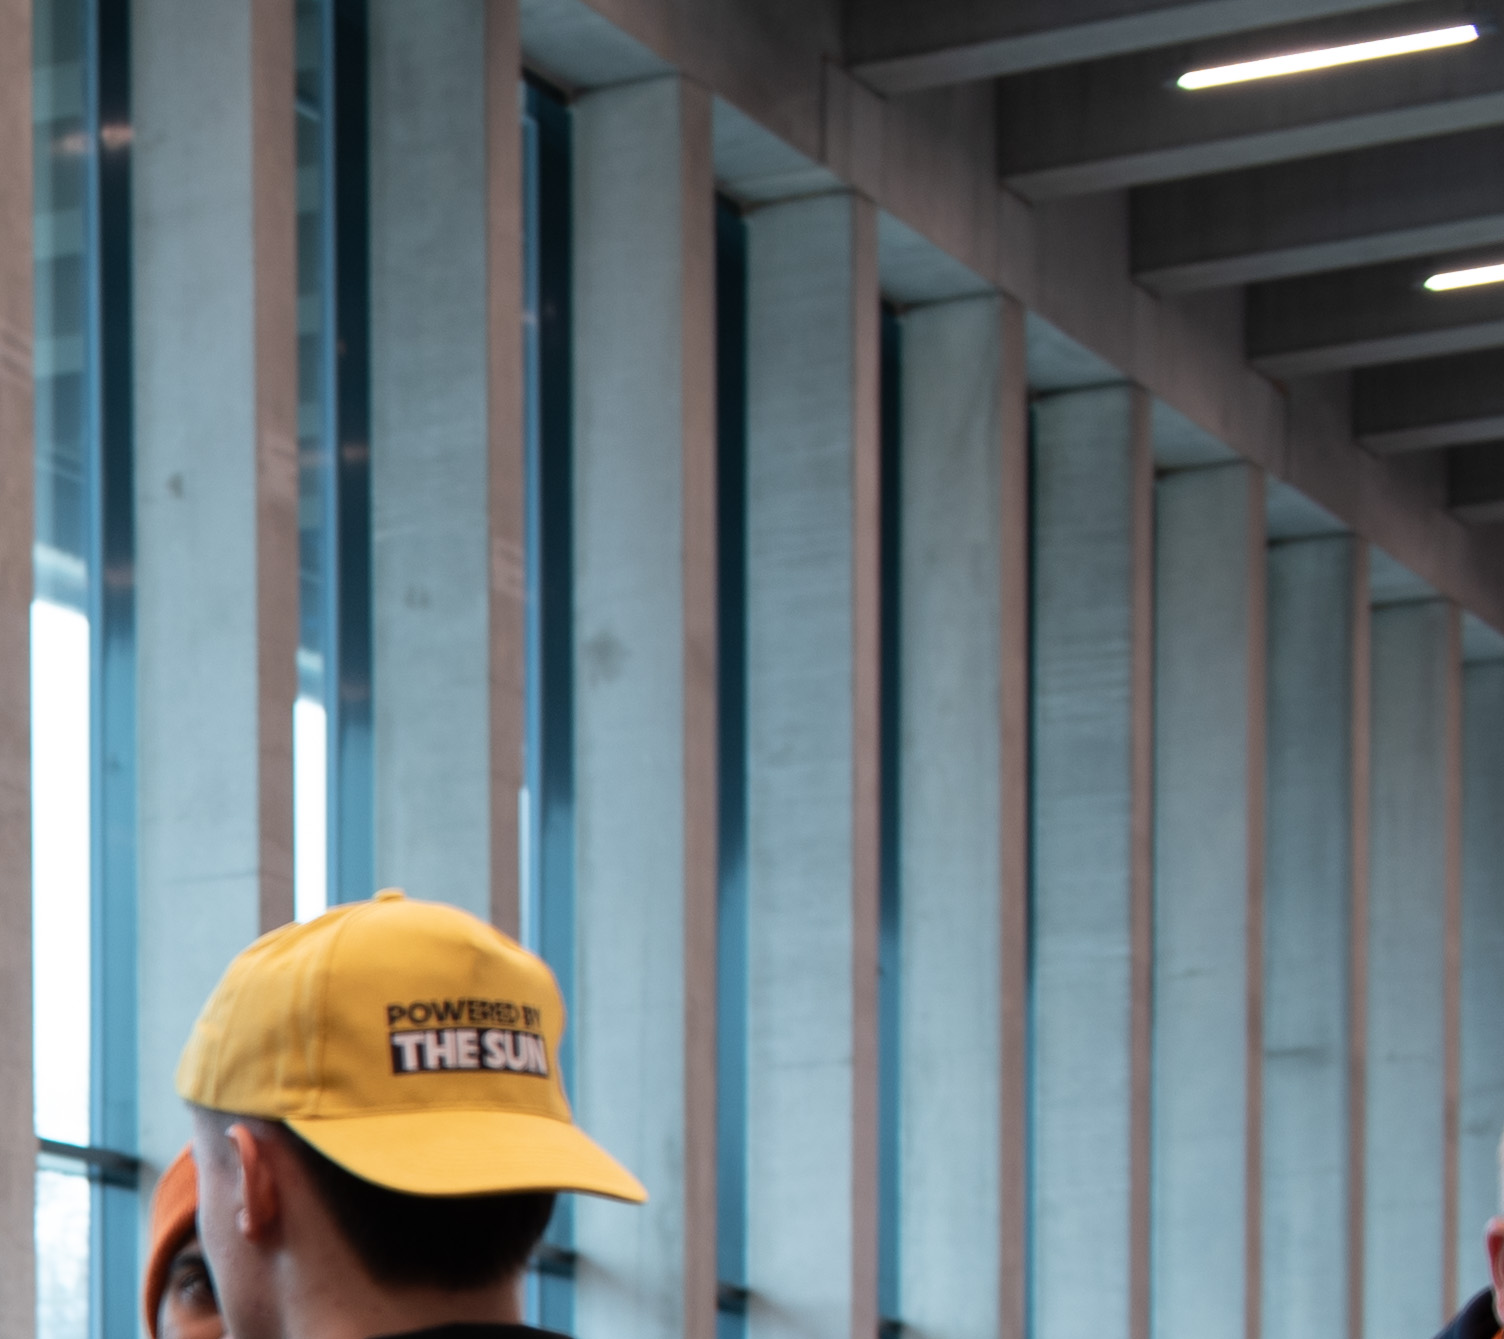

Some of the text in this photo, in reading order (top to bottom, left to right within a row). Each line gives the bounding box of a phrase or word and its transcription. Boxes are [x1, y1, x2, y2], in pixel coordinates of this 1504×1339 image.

[387, 999, 541, 1028] POWERED BY
[392, 1028, 548, 1076] THE SUN
